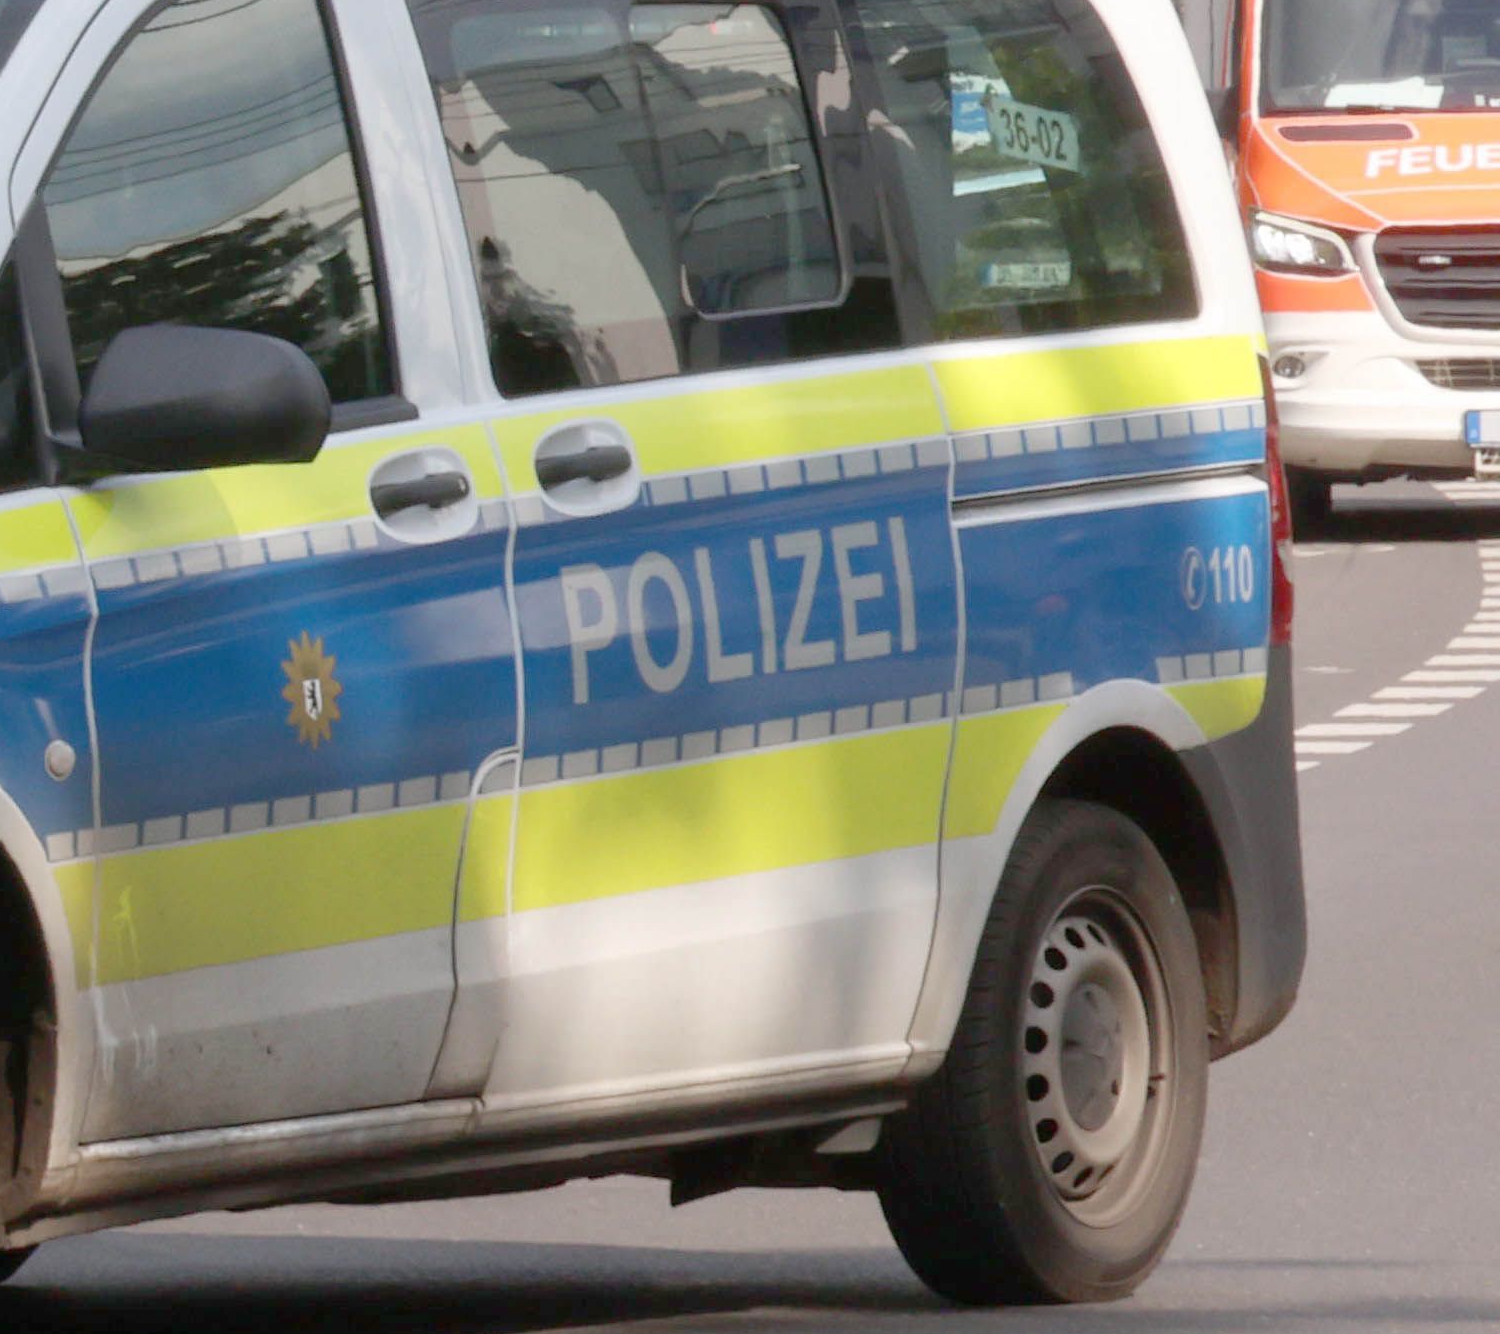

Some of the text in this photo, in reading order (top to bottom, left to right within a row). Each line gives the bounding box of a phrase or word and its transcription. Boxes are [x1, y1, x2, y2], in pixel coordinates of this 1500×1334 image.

[999, 108, 1068, 161] 36-02
[1365, 143, 1500, 179] FEUE
[1208, 544, 1252, 604] 110
[560, 516, 916, 704] POLIZEI
